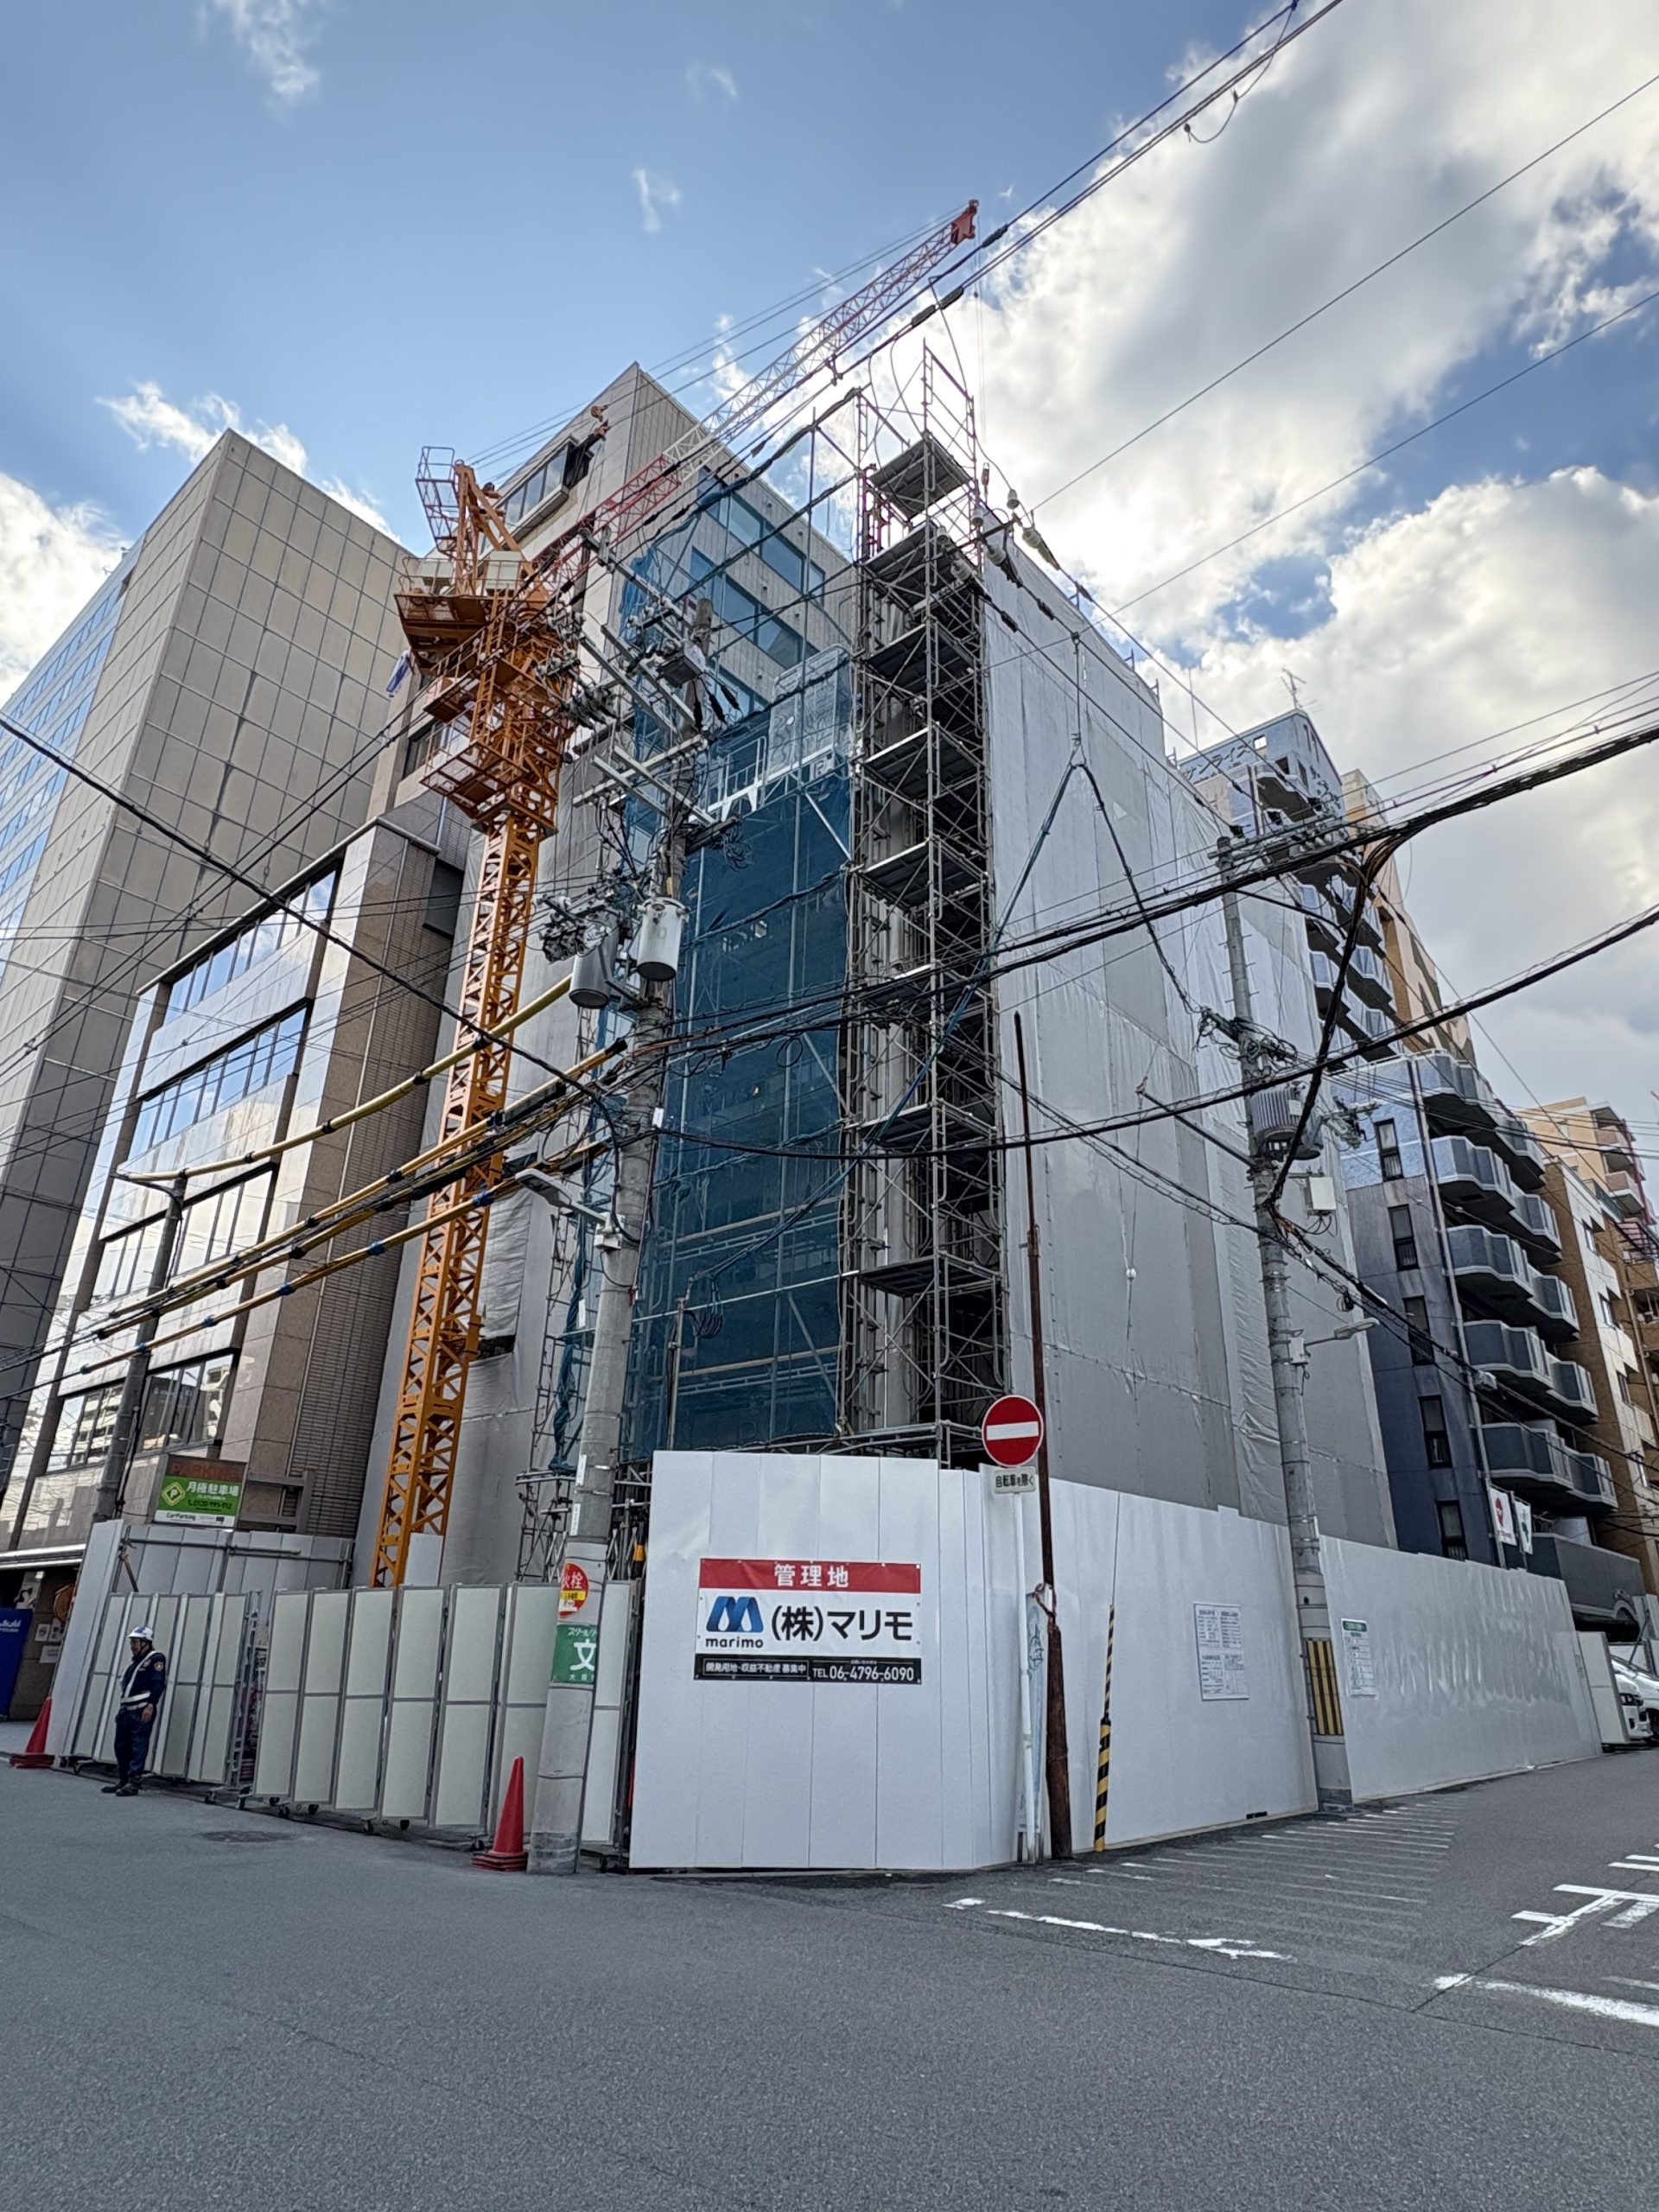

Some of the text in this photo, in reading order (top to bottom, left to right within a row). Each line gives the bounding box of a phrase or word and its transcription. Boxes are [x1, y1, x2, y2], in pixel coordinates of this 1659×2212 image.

[170, 1462, 239, 1481] PARKING
[995, 1473, 1034, 1487] 自転車を除く
[187, 1481, 239, 1497] 月極駐車場
[774, 1563, 849, 1587] 管理地
[772, 1605, 913, 1641] (株)マリモ
[705, 1636, 764, 1649] marimo
[570, 1639, 596, 1671] 文
[812, 1666, 914, 1681] TEL 06-4796-6090
